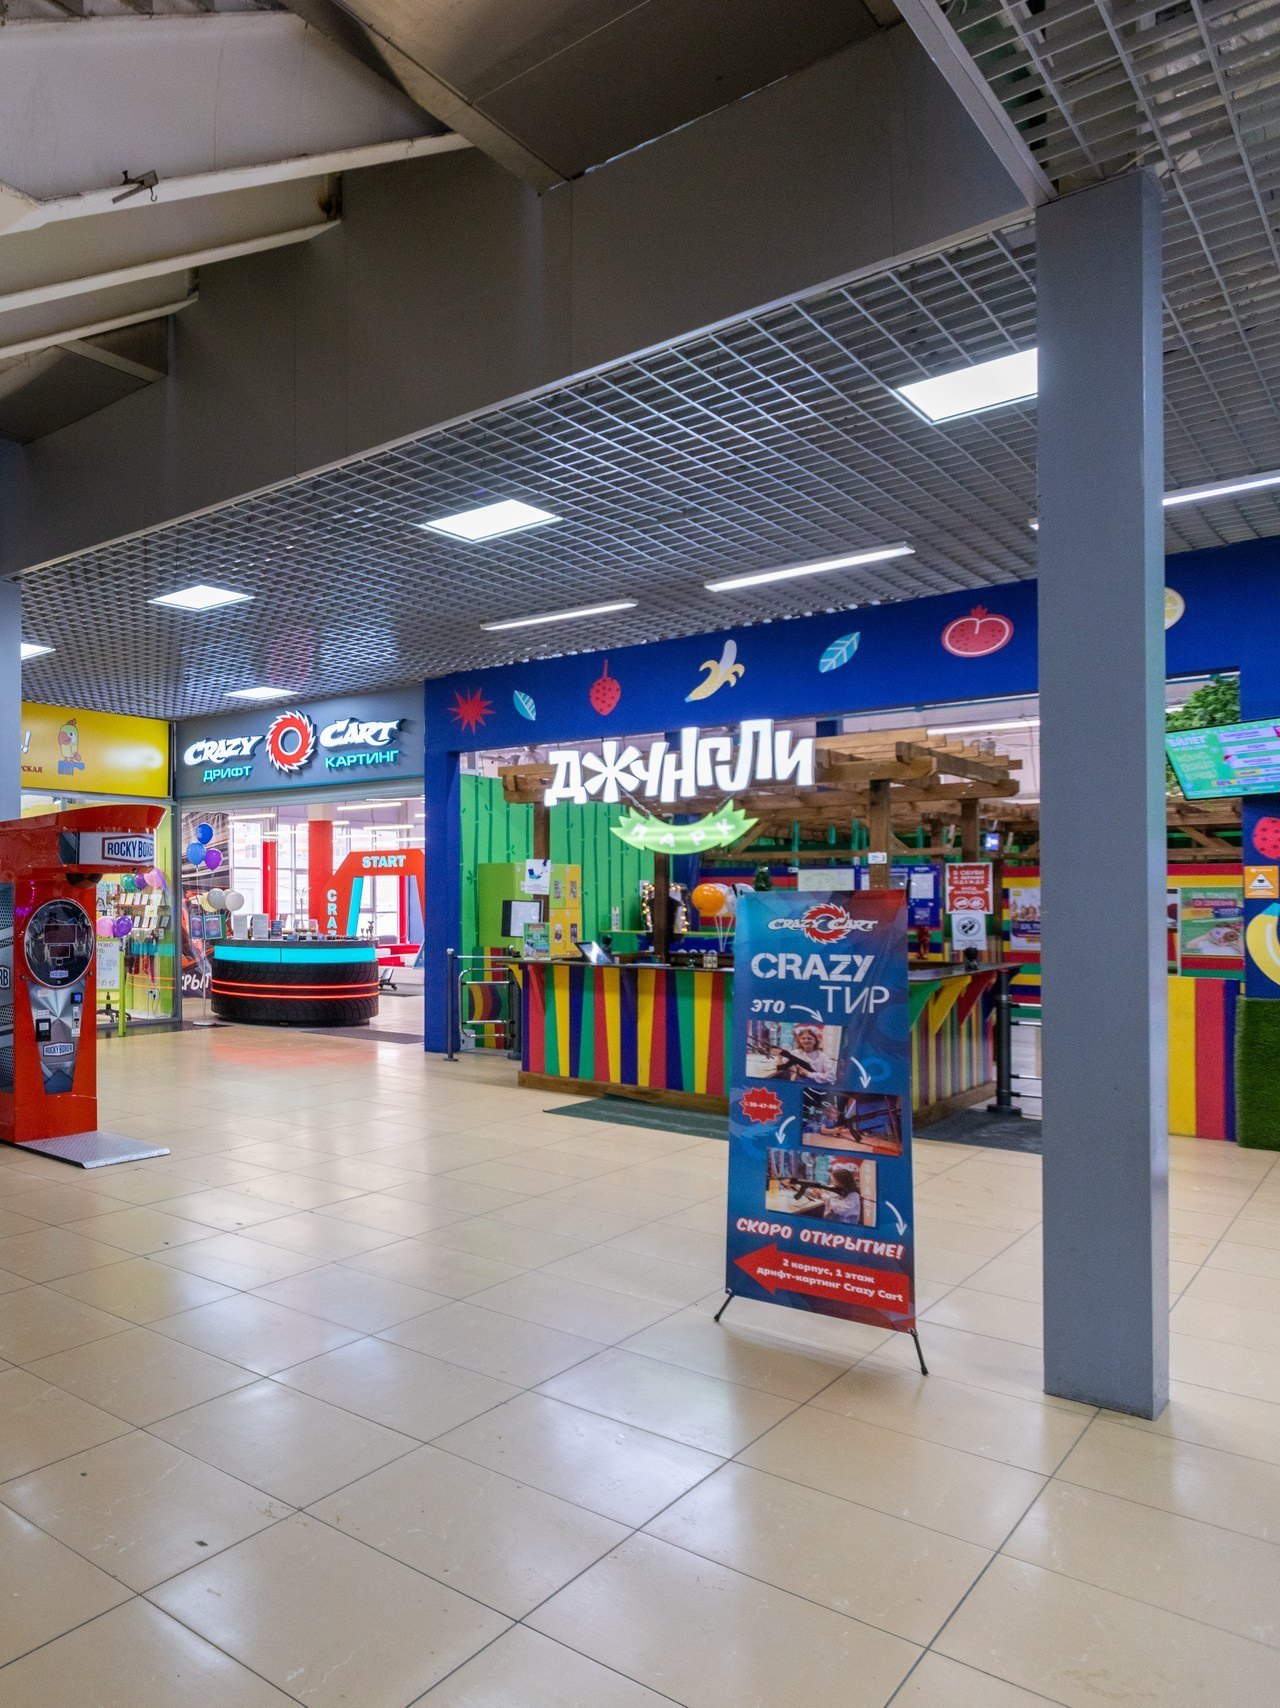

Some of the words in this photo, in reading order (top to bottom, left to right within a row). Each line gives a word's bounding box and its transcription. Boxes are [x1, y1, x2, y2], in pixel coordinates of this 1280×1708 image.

[183, 735, 263, 766] CRAZY
[319, 719, 400, 748] CART
[203, 765, 252, 782] ДРИФТ
[325, 750, 399, 768] КАРТИНГ
[544, 719, 815, 807] ДЖУНГЛИ
[630, 818, 735, 848] ПАРК
[107, 840, 137, 858] ROCKY
[138, 840, 154, 858] BOXE
[362, 855, 406, 868] START
[768, 917, 824, 931] CRAZY
[827, 915, 878, 932] CART
[181, 972, 212, 991] РЫТ
[751, 952, 875, 982] CRAZY
[750, 999, 786, 1014] ЭТО
[819, 985, 890, 1014] ТИР
[736, 1218, 793, 1240] СКОРО
[799, 1228, 905, 1260] ОТКРЫТИЕ!
[756, 1266, 841, 1289] дрифт-картинг
[843, 1283, 876, 1298] Crazy
[877, 1289, 904, 1302] Cart
[782, 1258, 790, 1267] 2
[791, 1261, 834, 1277] корпус,
[835, 1269, 843, 1278] 1
[844, 1272, 876, 1284] этаж
